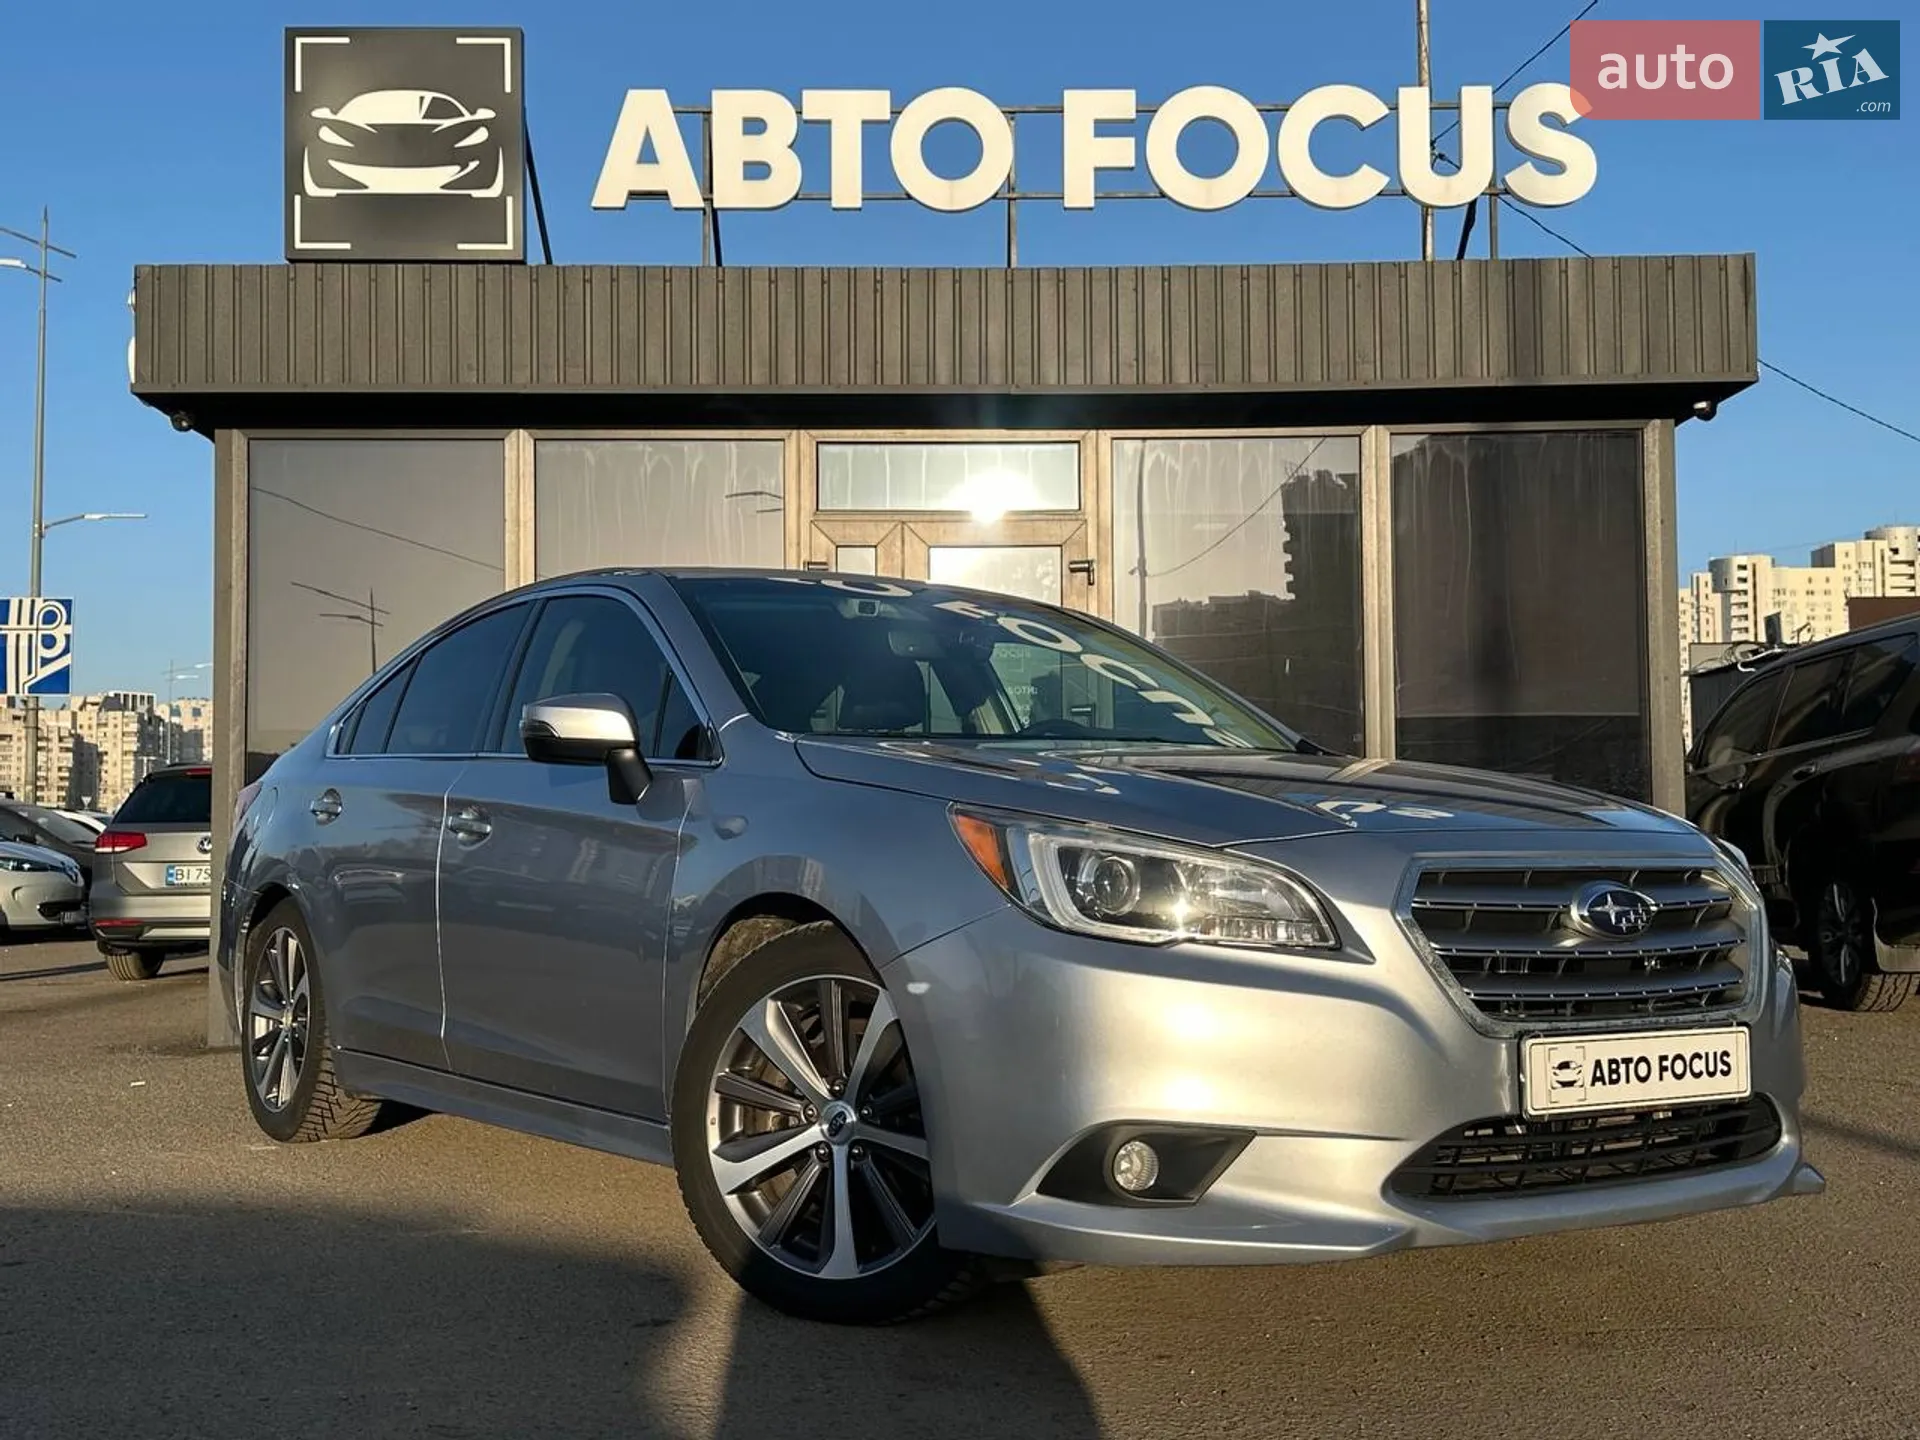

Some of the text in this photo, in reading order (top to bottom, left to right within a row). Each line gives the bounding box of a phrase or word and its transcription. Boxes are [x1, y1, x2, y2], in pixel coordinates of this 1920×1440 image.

[591, 82, 1598, 213] АВТО FOCUS
[1590, 1050, 1732, 1087] АВТО FOCUS
